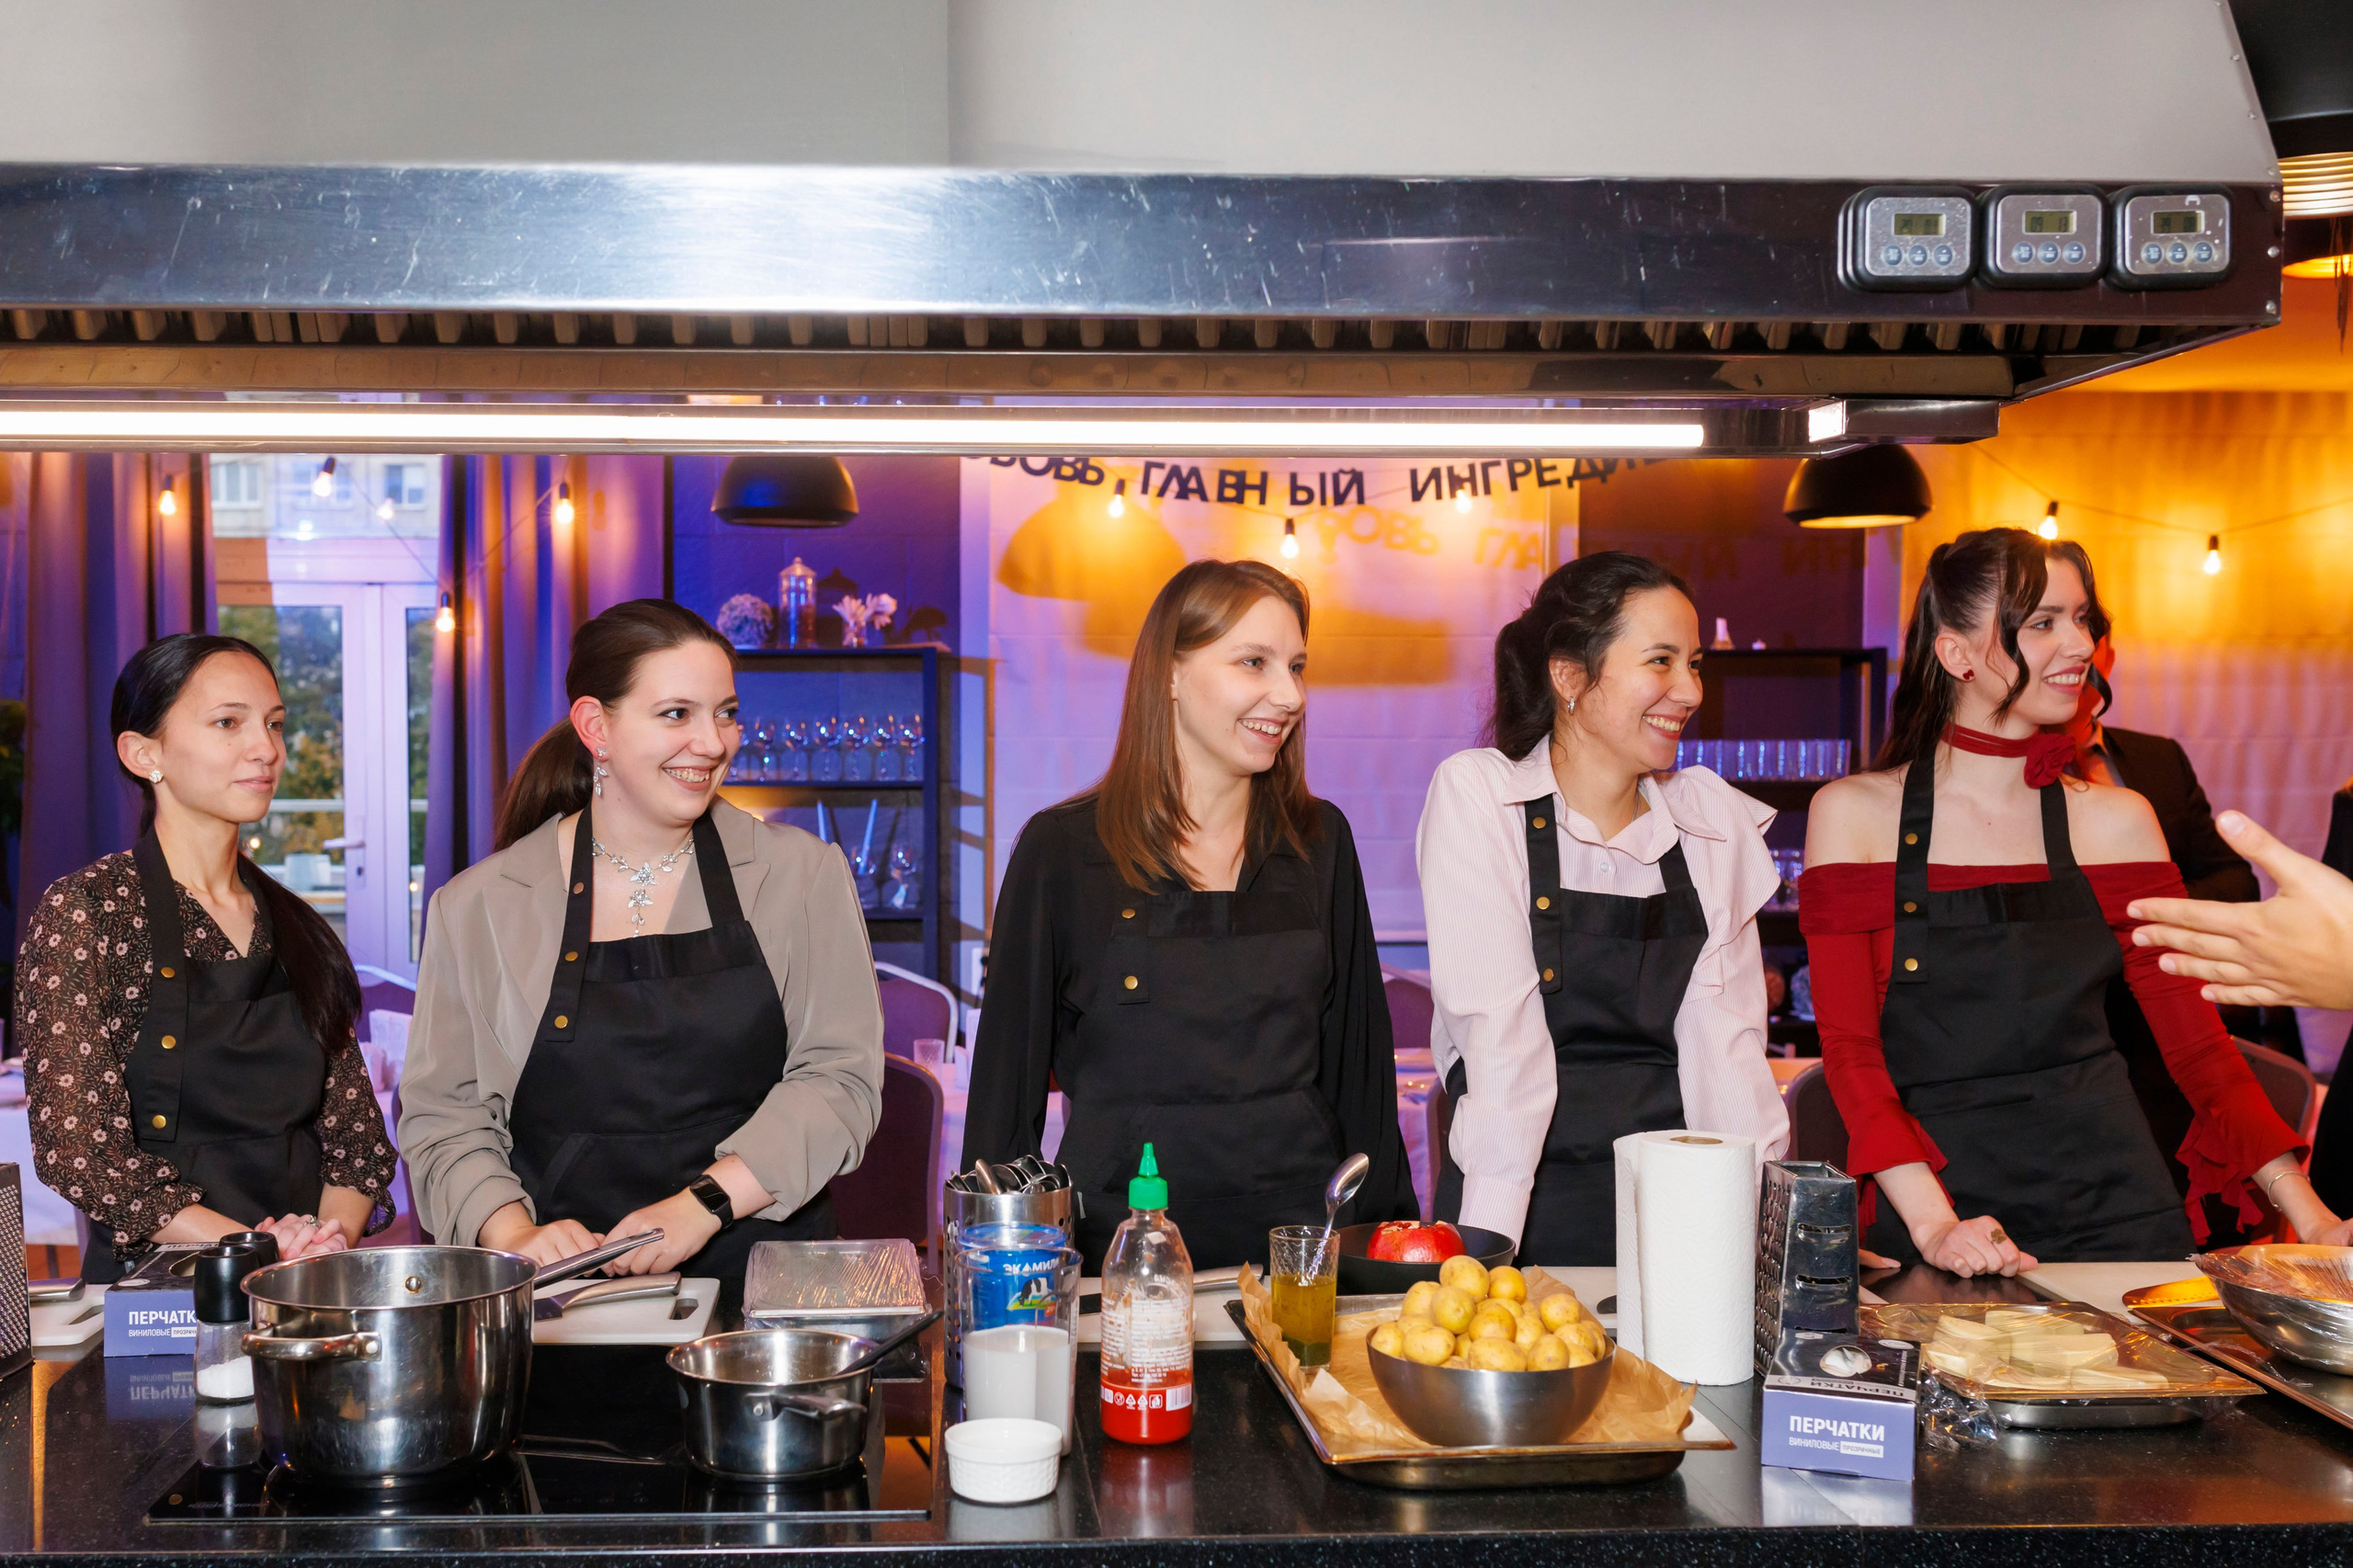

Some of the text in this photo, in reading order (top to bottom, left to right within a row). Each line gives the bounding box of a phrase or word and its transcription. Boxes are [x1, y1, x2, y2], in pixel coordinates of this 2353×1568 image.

[989, 457, 1105, 486] ОВЬ
[1410, 457, 1666, 503] ИНГРЕД
[129, 1310, 199, 1325] ПЕРЧАТК
[129, 1328, 172, 1337] ВИНИЛОВЫЕ
[1789, 1415, 1885, 1441] ПЕРЧАТКИ
[1789, 1437, 1839, 1451] ВИНИЛОВЫЕ
